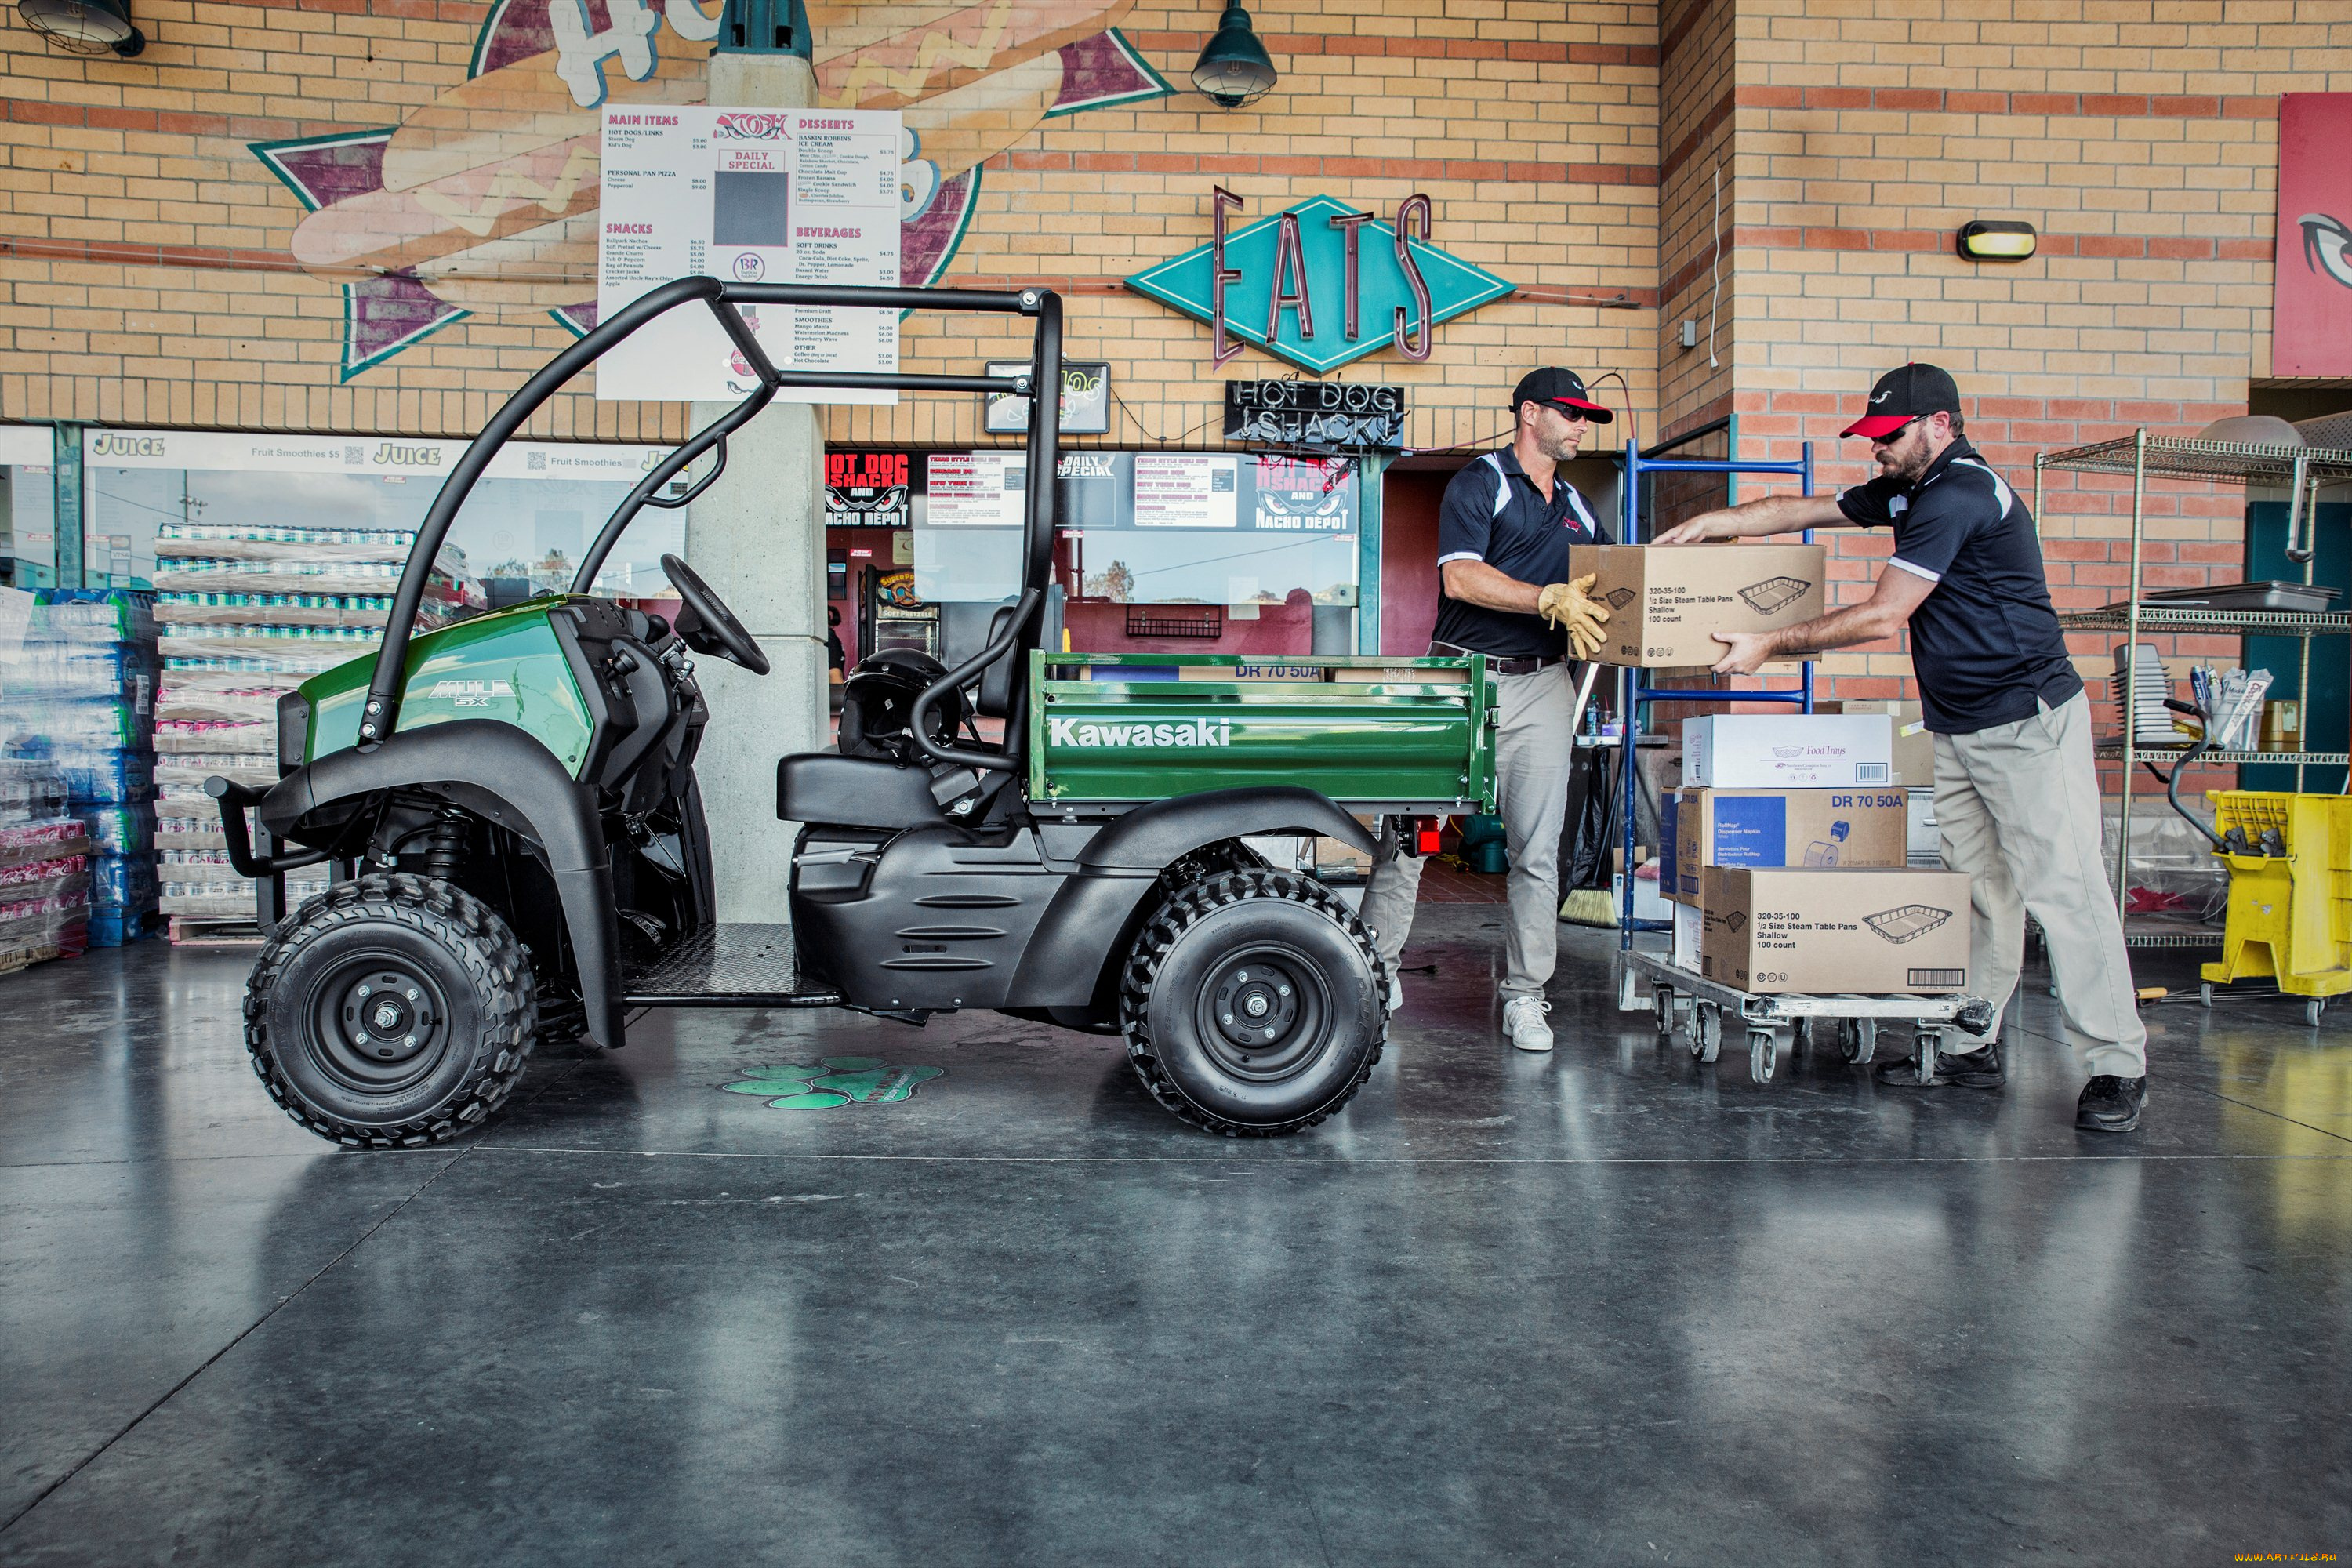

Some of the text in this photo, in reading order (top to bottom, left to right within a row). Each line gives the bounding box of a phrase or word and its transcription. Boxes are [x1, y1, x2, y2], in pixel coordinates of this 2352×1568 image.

[608, 114, 679, 125] MAIN ITEMS
[799, 119, 854, 129] DESSERTS
[729, 161, 775, 169] SPECIAL
[606, 223, 653, 234] SNACKS
[796, 227, 862, 238] BEVERAGES
[1214, 184, 1432, 372] EATS
[1233, 381, 1396, 412] HOT DOG
[1258, 411, 1374, 444] SHACK
[93, 434, 165, 457] JUICE
[252, 448, 339, 459] Fruit Smoothies $5
[373, 443, 441, 466] JUICE
[551, 457, 622, 467] Fruit Smoothies
[1063, 456, 1098, 466] DAILY
[866, 454, 909, 485] DOG
[831, 474, 894, 488] SHACK
[850, 488, 873, 496] AND
[826, 505, 908, 525] ACHO DEPOT
[1256, 507, 1348, 529] NACHO DEPOT
[1236, 666, 1319, 678] DR 70 50A
[428, 680, 516, 698] MULE
[455, 698, 489, 706] SX
[1051, 718, 1229, 746] Kawasaki
[1807, 746, 1846, 757] Food Trays
[1832, 796, 1903, 808] DR 70 50A
